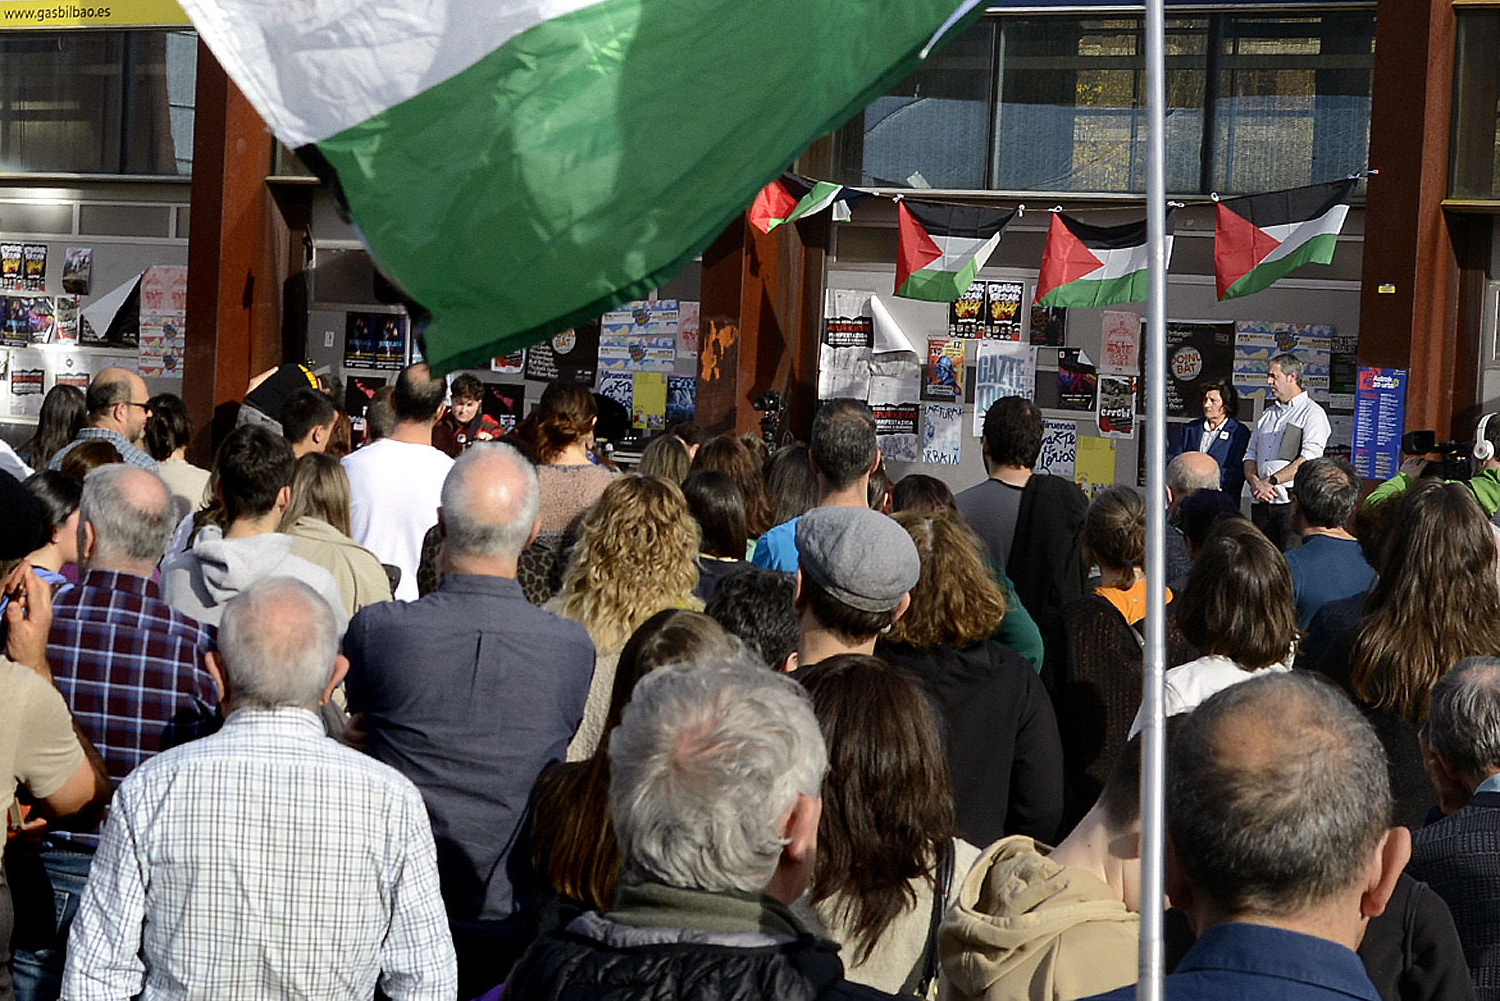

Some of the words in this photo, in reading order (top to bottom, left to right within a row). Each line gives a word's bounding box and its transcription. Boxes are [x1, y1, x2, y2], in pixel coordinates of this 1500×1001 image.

[3, 4, 112, 22] www.gasbilbao.es
[977, 354, 1026, 389] GAZTE
[1176, 363, 1196, 374] BAT
